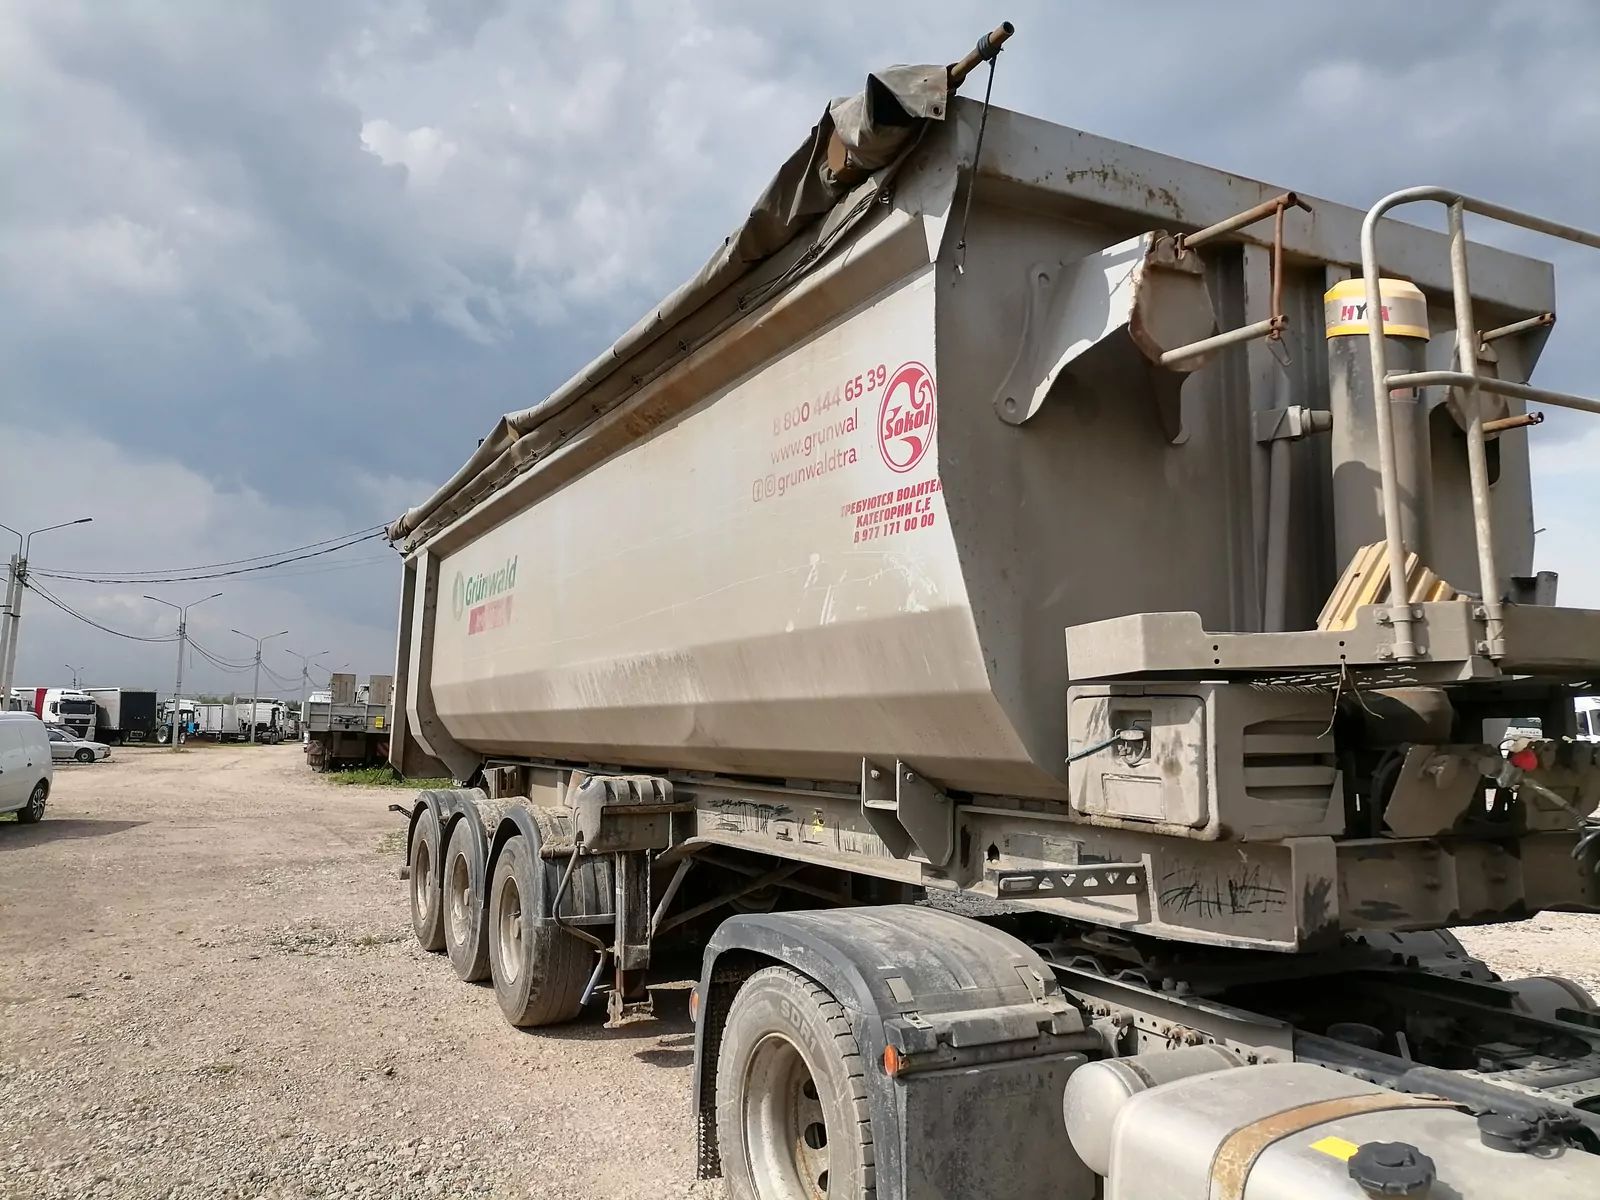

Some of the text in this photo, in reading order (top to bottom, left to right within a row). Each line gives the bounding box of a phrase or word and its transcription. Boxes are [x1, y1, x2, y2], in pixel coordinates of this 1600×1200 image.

[1341, 302, 1390, 321] HYA
[784, 402, 810, 432] 800
[813, 387, 842, 416] 444
[844, 375, 863, 402] 65
[867, 364, 887, 392] 39
[771, 407, 858, 465] www.grunwal
[884, 403, 931, 441] Sokol
[777, 447, 858, 497] grunwaldtra
[840, 491, 894, 518] ТРЕБУЮТСЯ
[856, 502, 913, 528] КАТЕГОРИИ
[853, 513, 935, 543] 8 977 171 00 00
[466, 555, 518, 606] Grünwald
[780, 999, 817, 1053] SDR1
